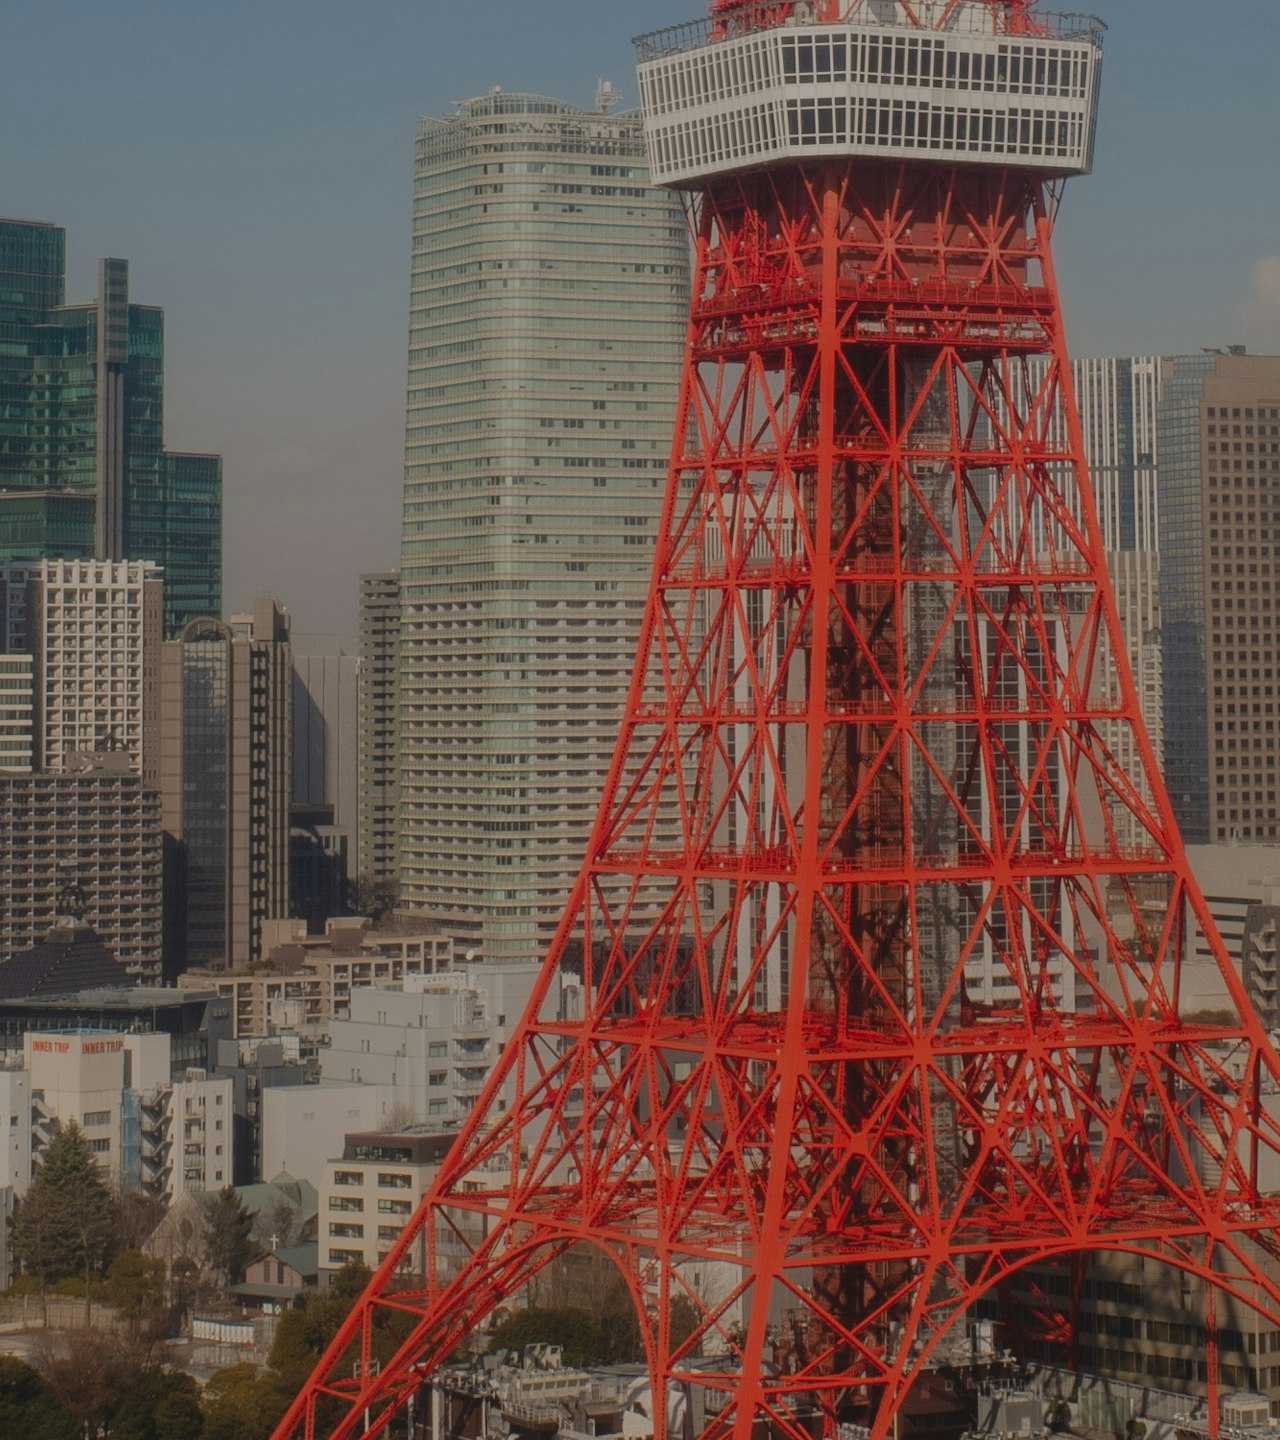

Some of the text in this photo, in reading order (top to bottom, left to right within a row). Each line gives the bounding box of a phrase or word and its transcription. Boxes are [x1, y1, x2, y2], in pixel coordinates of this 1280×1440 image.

[32, 1040, 70, 1053] INNER TRIP
[82, 1040, 123, 1054] INNER TRIP
